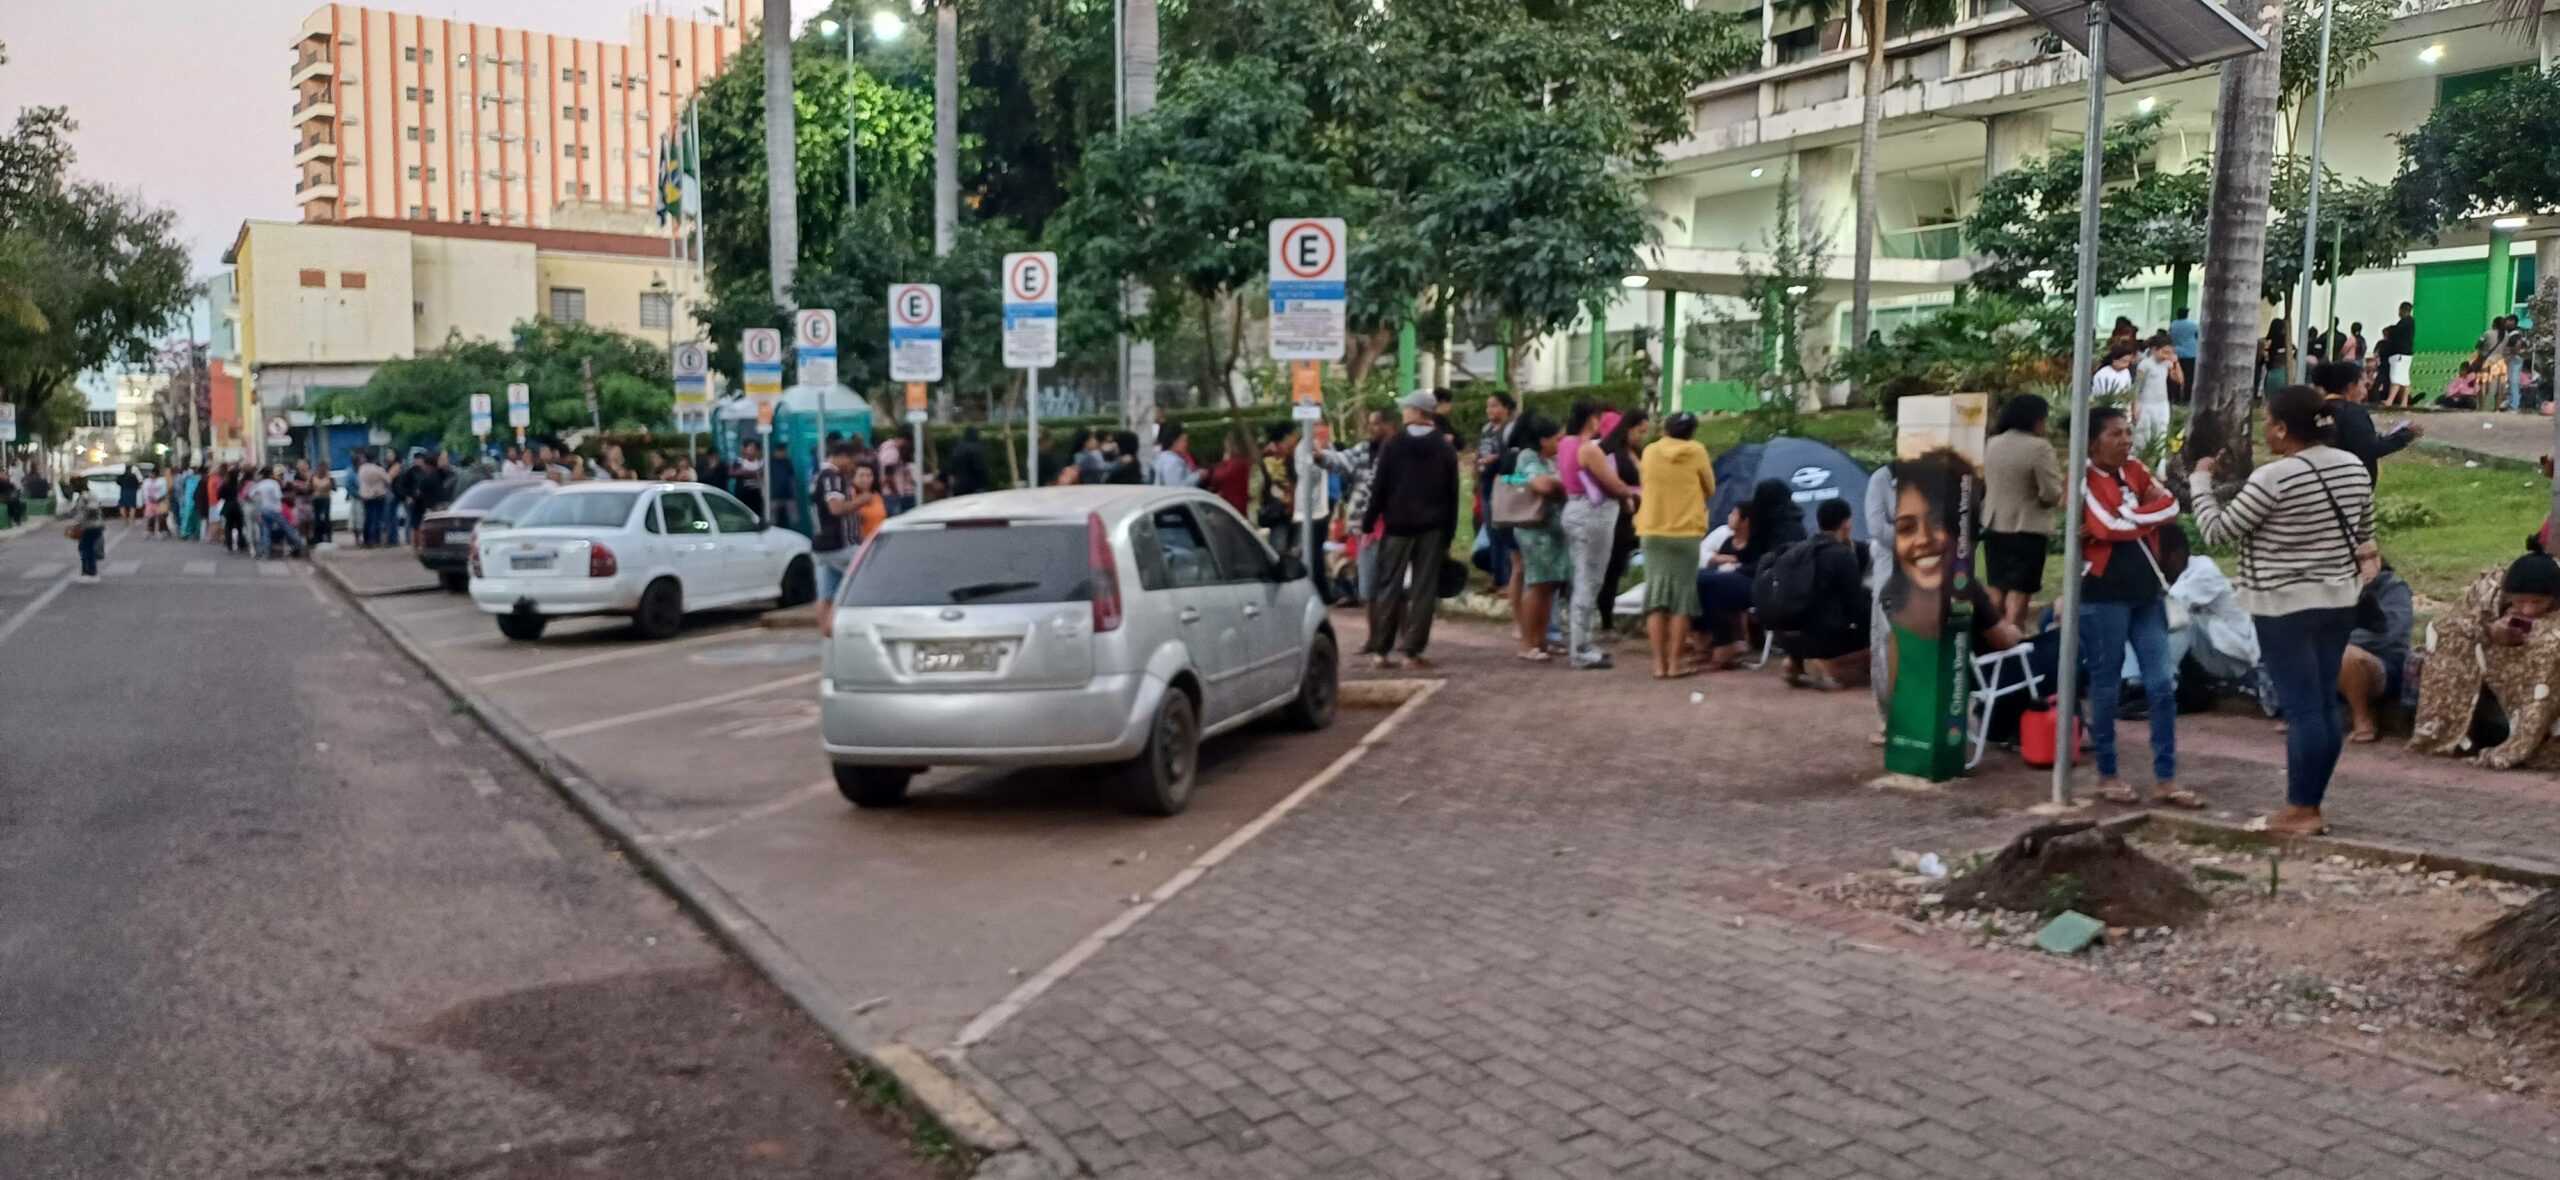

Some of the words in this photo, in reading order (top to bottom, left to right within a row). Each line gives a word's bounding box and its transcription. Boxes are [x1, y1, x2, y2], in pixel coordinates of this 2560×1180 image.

[1300, 235, 1318, 266] E
[1024, 266, 1036, 291] E
[909, 295, 922, 317] E
[812, 319, 822, 338] E
[1959, 474, 1972, 513] Verde
[1957, 512, 1970, 559] Cidade
[1953, 631, 1967, 669] Verde
[1951, 669, 1964, 715] Cidade
